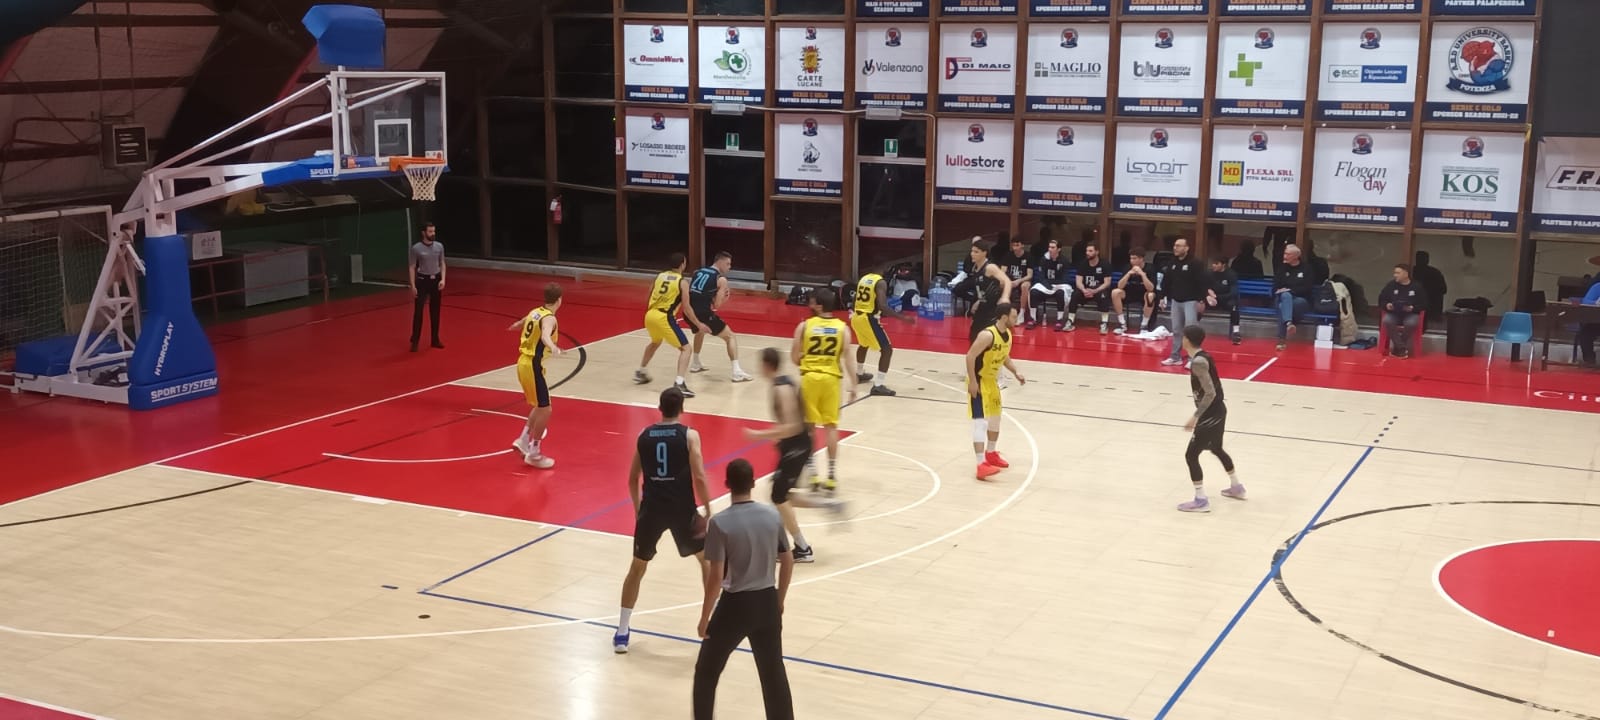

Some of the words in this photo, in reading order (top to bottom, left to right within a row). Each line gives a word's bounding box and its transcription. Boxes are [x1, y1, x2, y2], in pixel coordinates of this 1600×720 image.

[1456, 29, 1502, 50] UNIVERSITY
[876, 62, 923, 72] Valenzano
[1050, 62, 1102, 73] MAGLIO
[1460, 84, 1497, 92] POTENZA
[946, 154, 1005, 168] lullostore
[1224, 167, 1240, 176] MD
[1334, 161, 1387, 182] Flogan
[1442, 173, 1499, 194] KOS
[659, 281, 670, 294] 5
[691, 272, 710, 290] 20
[525, 320, 534, 338] 9
[154, 321, 174, 376] HYDROPLAY
[808, 336, 838, 356] 22
[656, 442, 668, 477] 9
